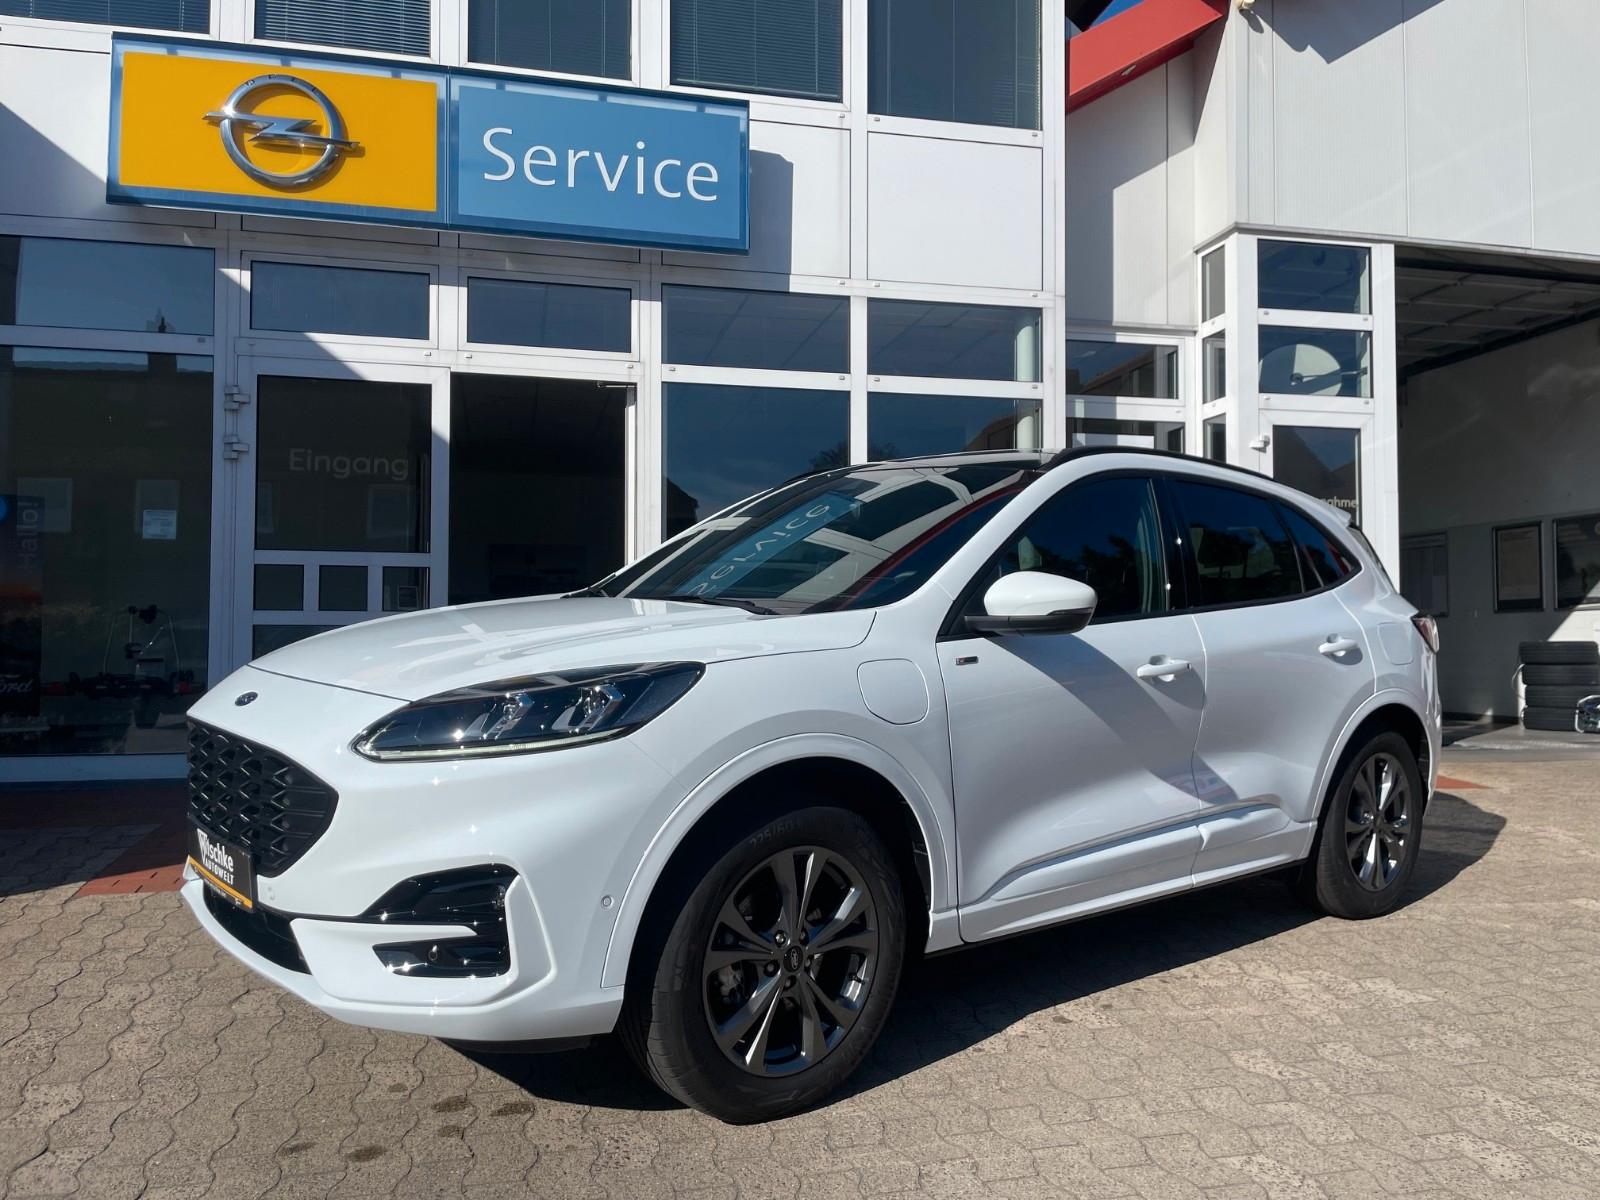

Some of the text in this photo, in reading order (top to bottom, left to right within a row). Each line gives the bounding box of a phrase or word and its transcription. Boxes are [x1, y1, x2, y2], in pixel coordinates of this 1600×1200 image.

[483, 127, 719, 201] Service
[289, 447, 409, 480] Eingang
[205, 858, 234, 885] AUTOWELT
